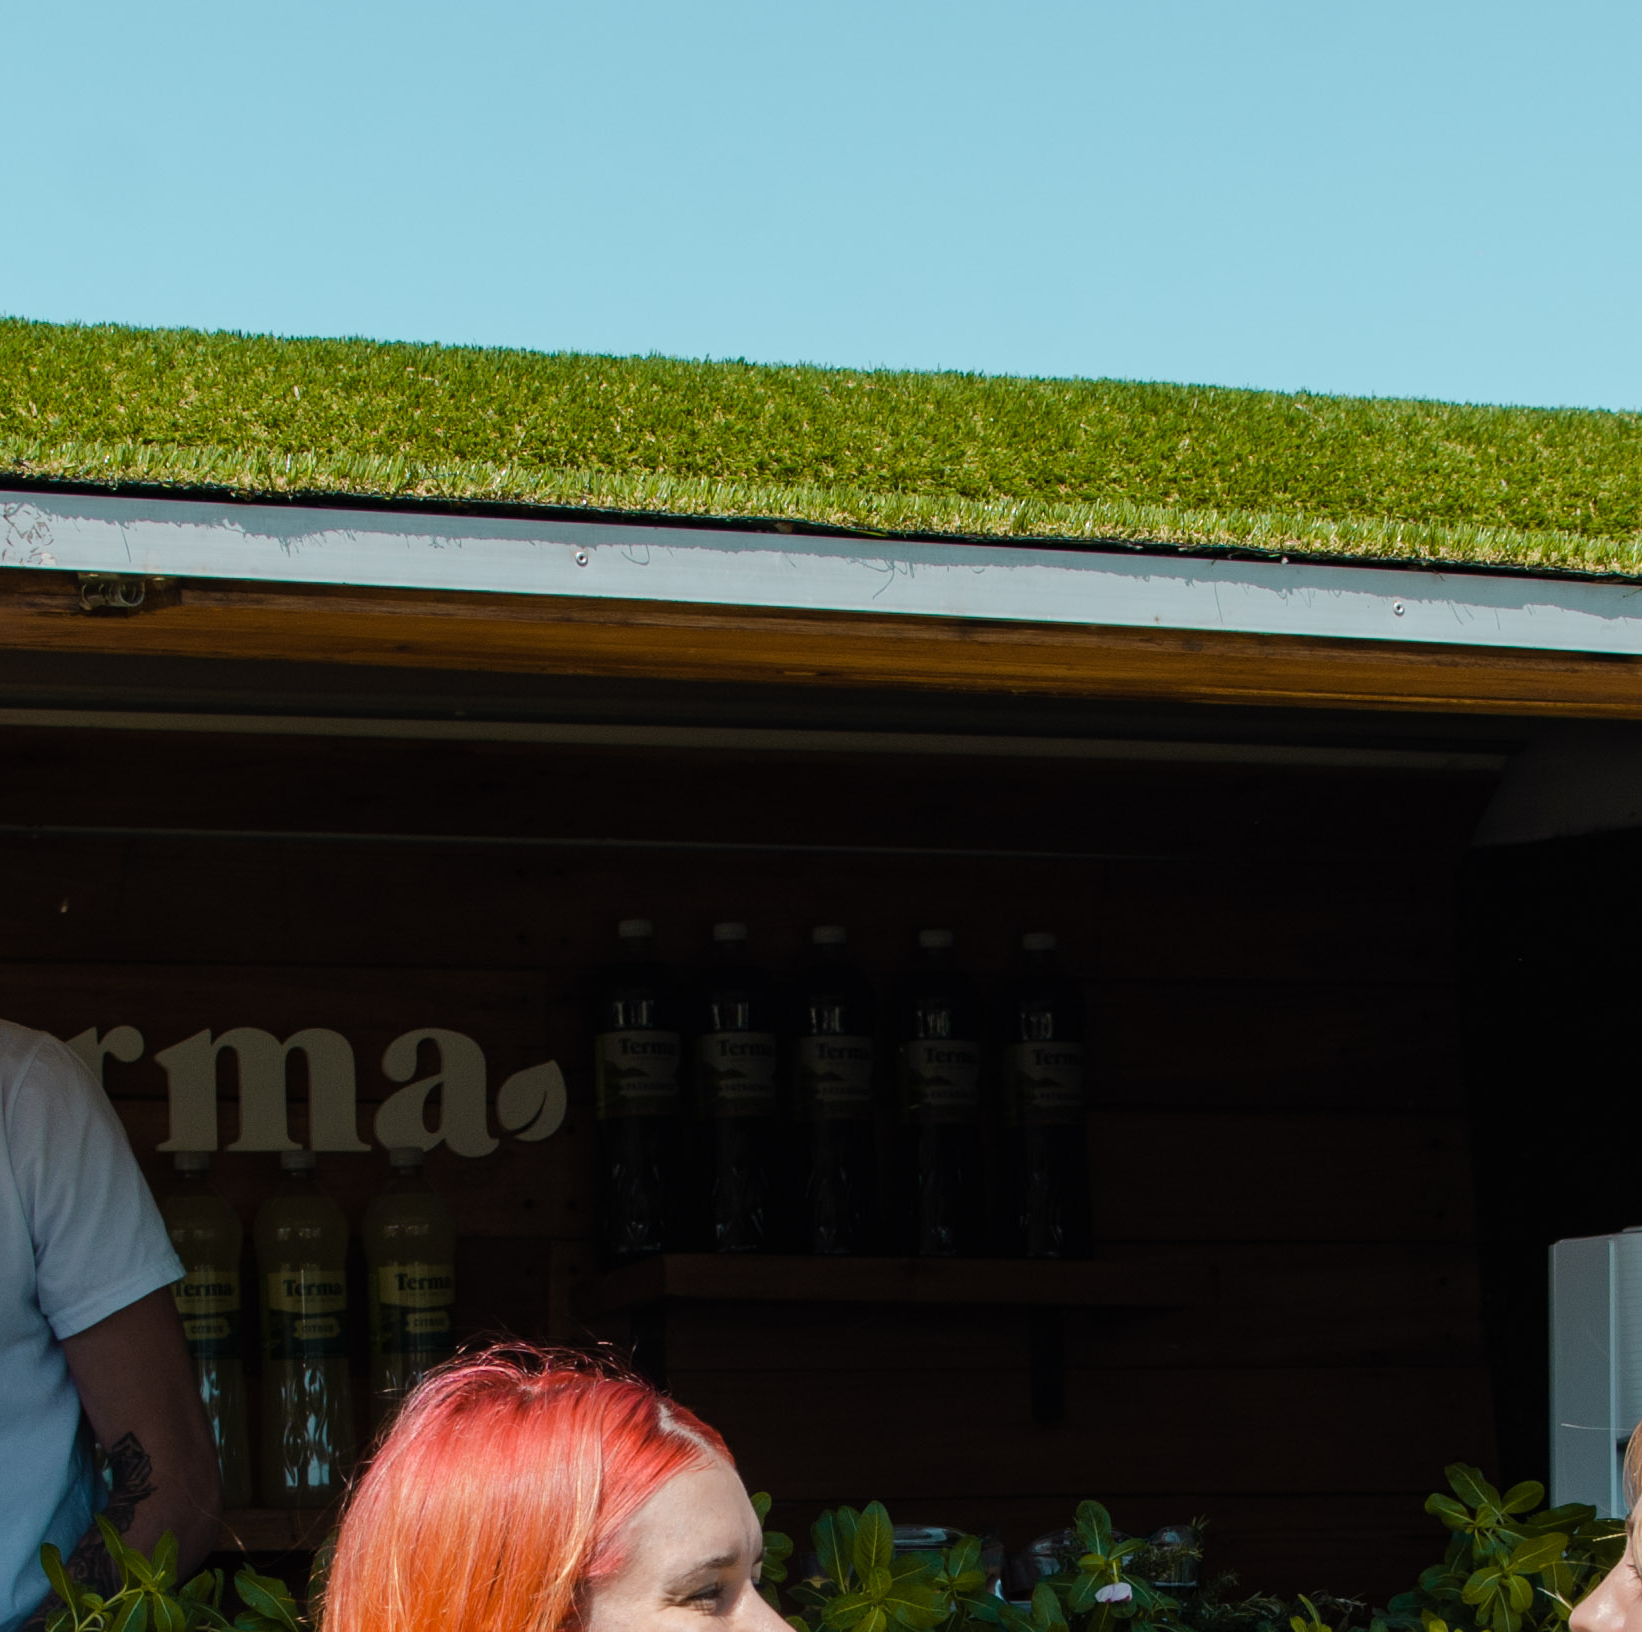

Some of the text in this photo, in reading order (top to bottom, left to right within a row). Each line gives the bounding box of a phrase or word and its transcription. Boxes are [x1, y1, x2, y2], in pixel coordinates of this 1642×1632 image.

[174, 1279, 233, 1298] Terma
[283, 1279, 342, 1298] Terma
[395, 1273, 452, 1291] Terma
